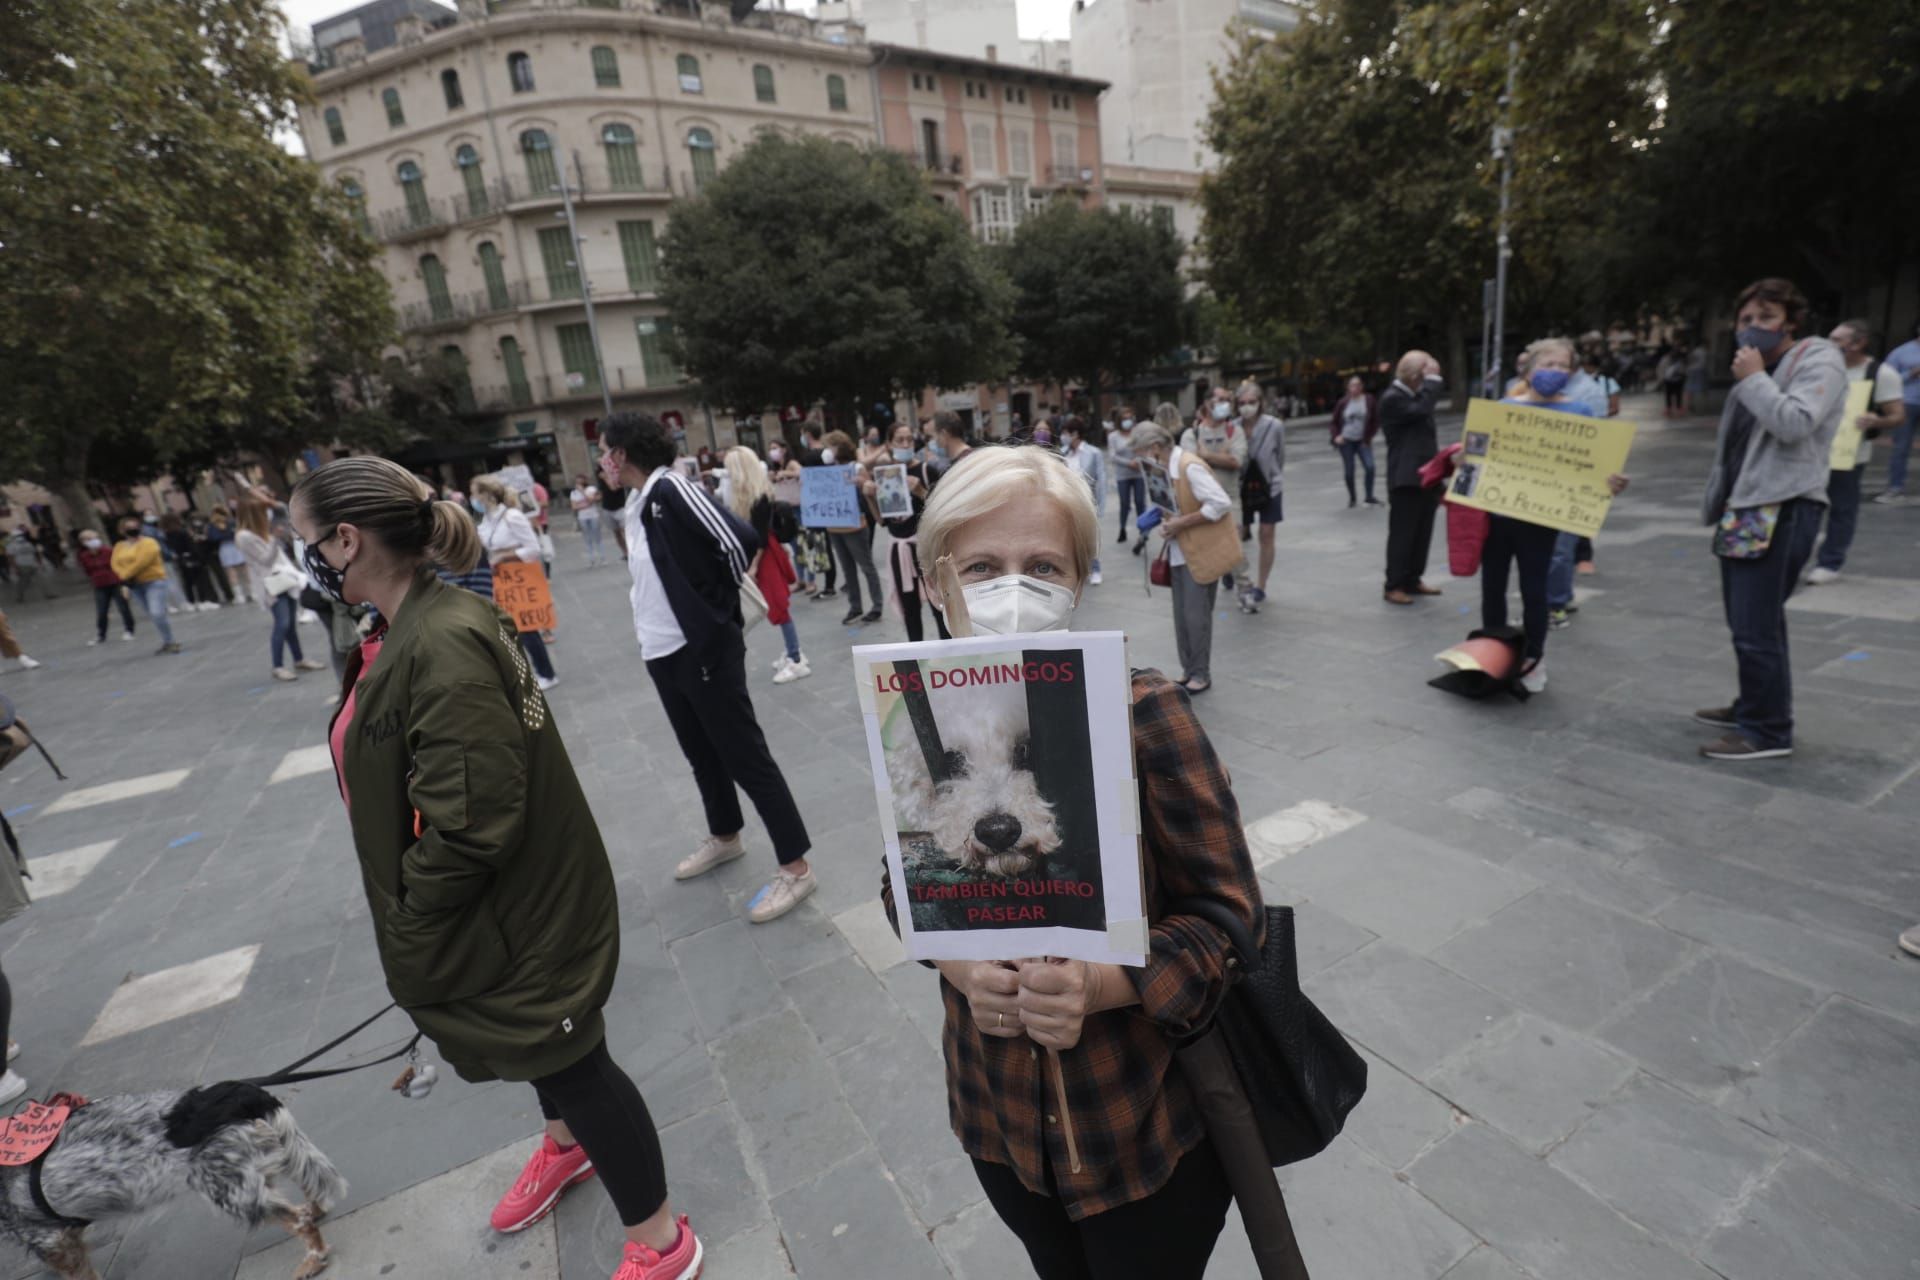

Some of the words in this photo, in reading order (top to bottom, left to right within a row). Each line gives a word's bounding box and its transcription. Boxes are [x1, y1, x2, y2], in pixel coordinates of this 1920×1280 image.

[1505, 411, 1598, 440] TRIPARTITO
[877, 672, 923, 693] LOS
[930, 662, 1074, 689] DOMINGOS
[1013, 880, 1094, 897] QUIERO
[967, 905, 1047, 922] PASEAR
